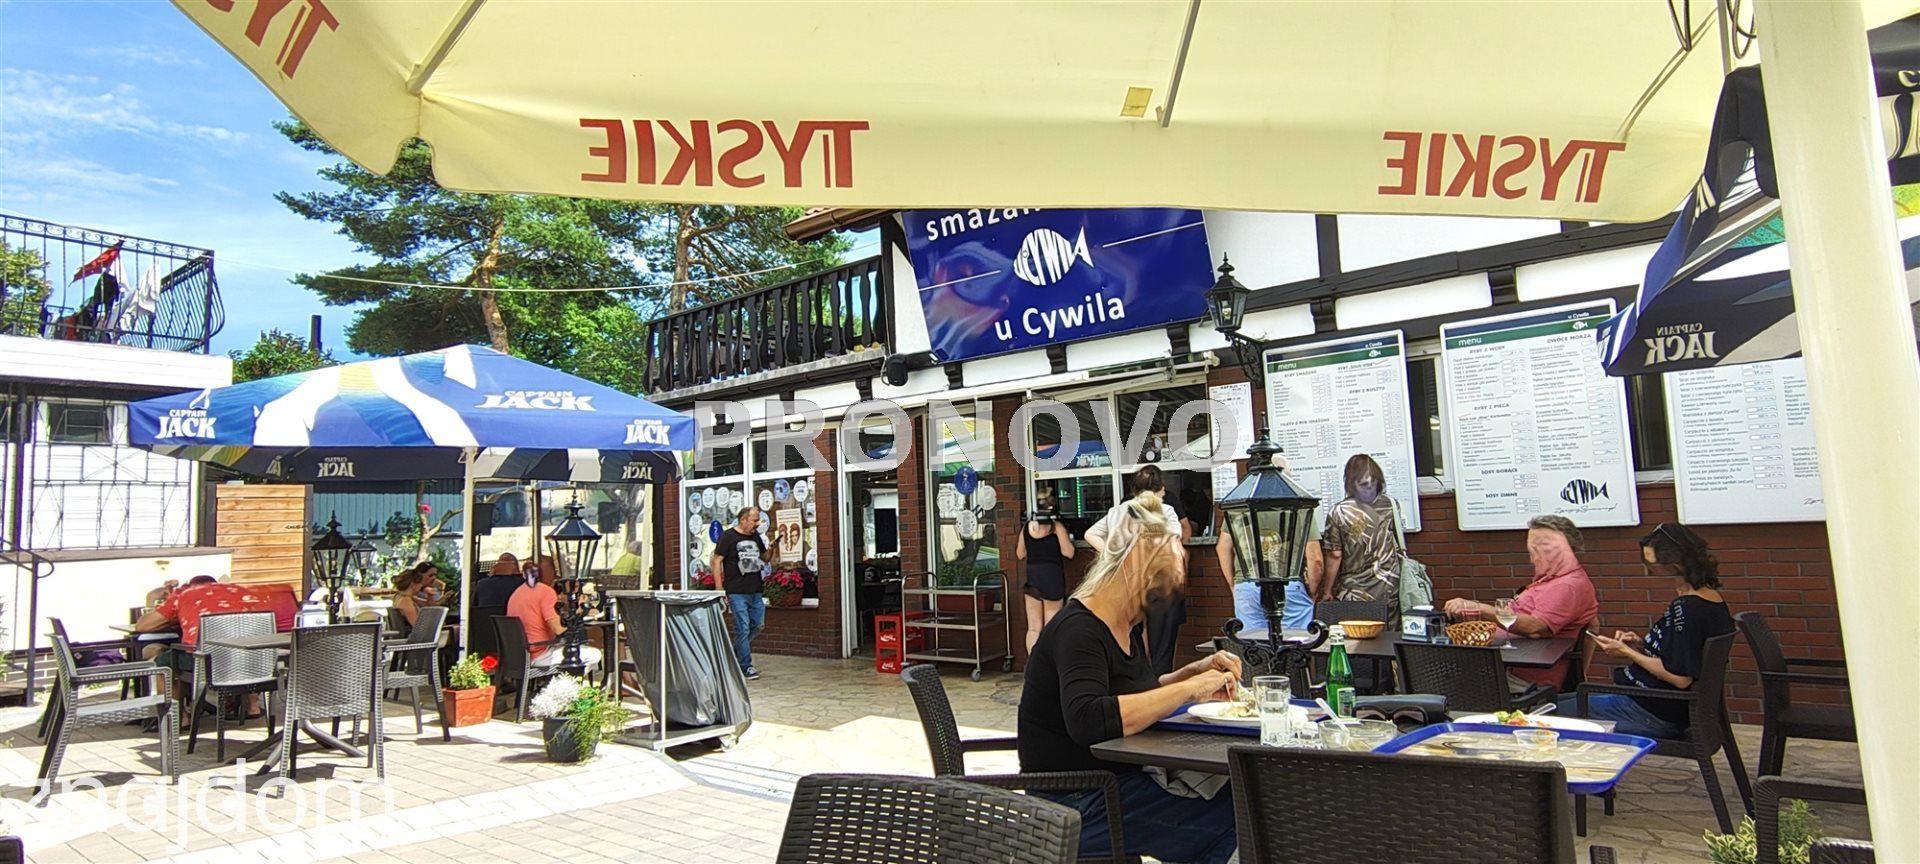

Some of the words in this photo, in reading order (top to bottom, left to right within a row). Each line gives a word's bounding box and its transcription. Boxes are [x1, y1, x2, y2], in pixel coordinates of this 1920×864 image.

[994, 318, 1013, 341] u
[1022, 291, 1126, 339] Cywila
[1458, 337, 1482, 347] menu
[1277, 362, 1297, 371] menu
[475, 395, 597, 411] JACK
[169, 409, 207, 418] CAPTAIN
[154, 416, 216, 439] JACK
[623, 423, 671, 446] JACK
